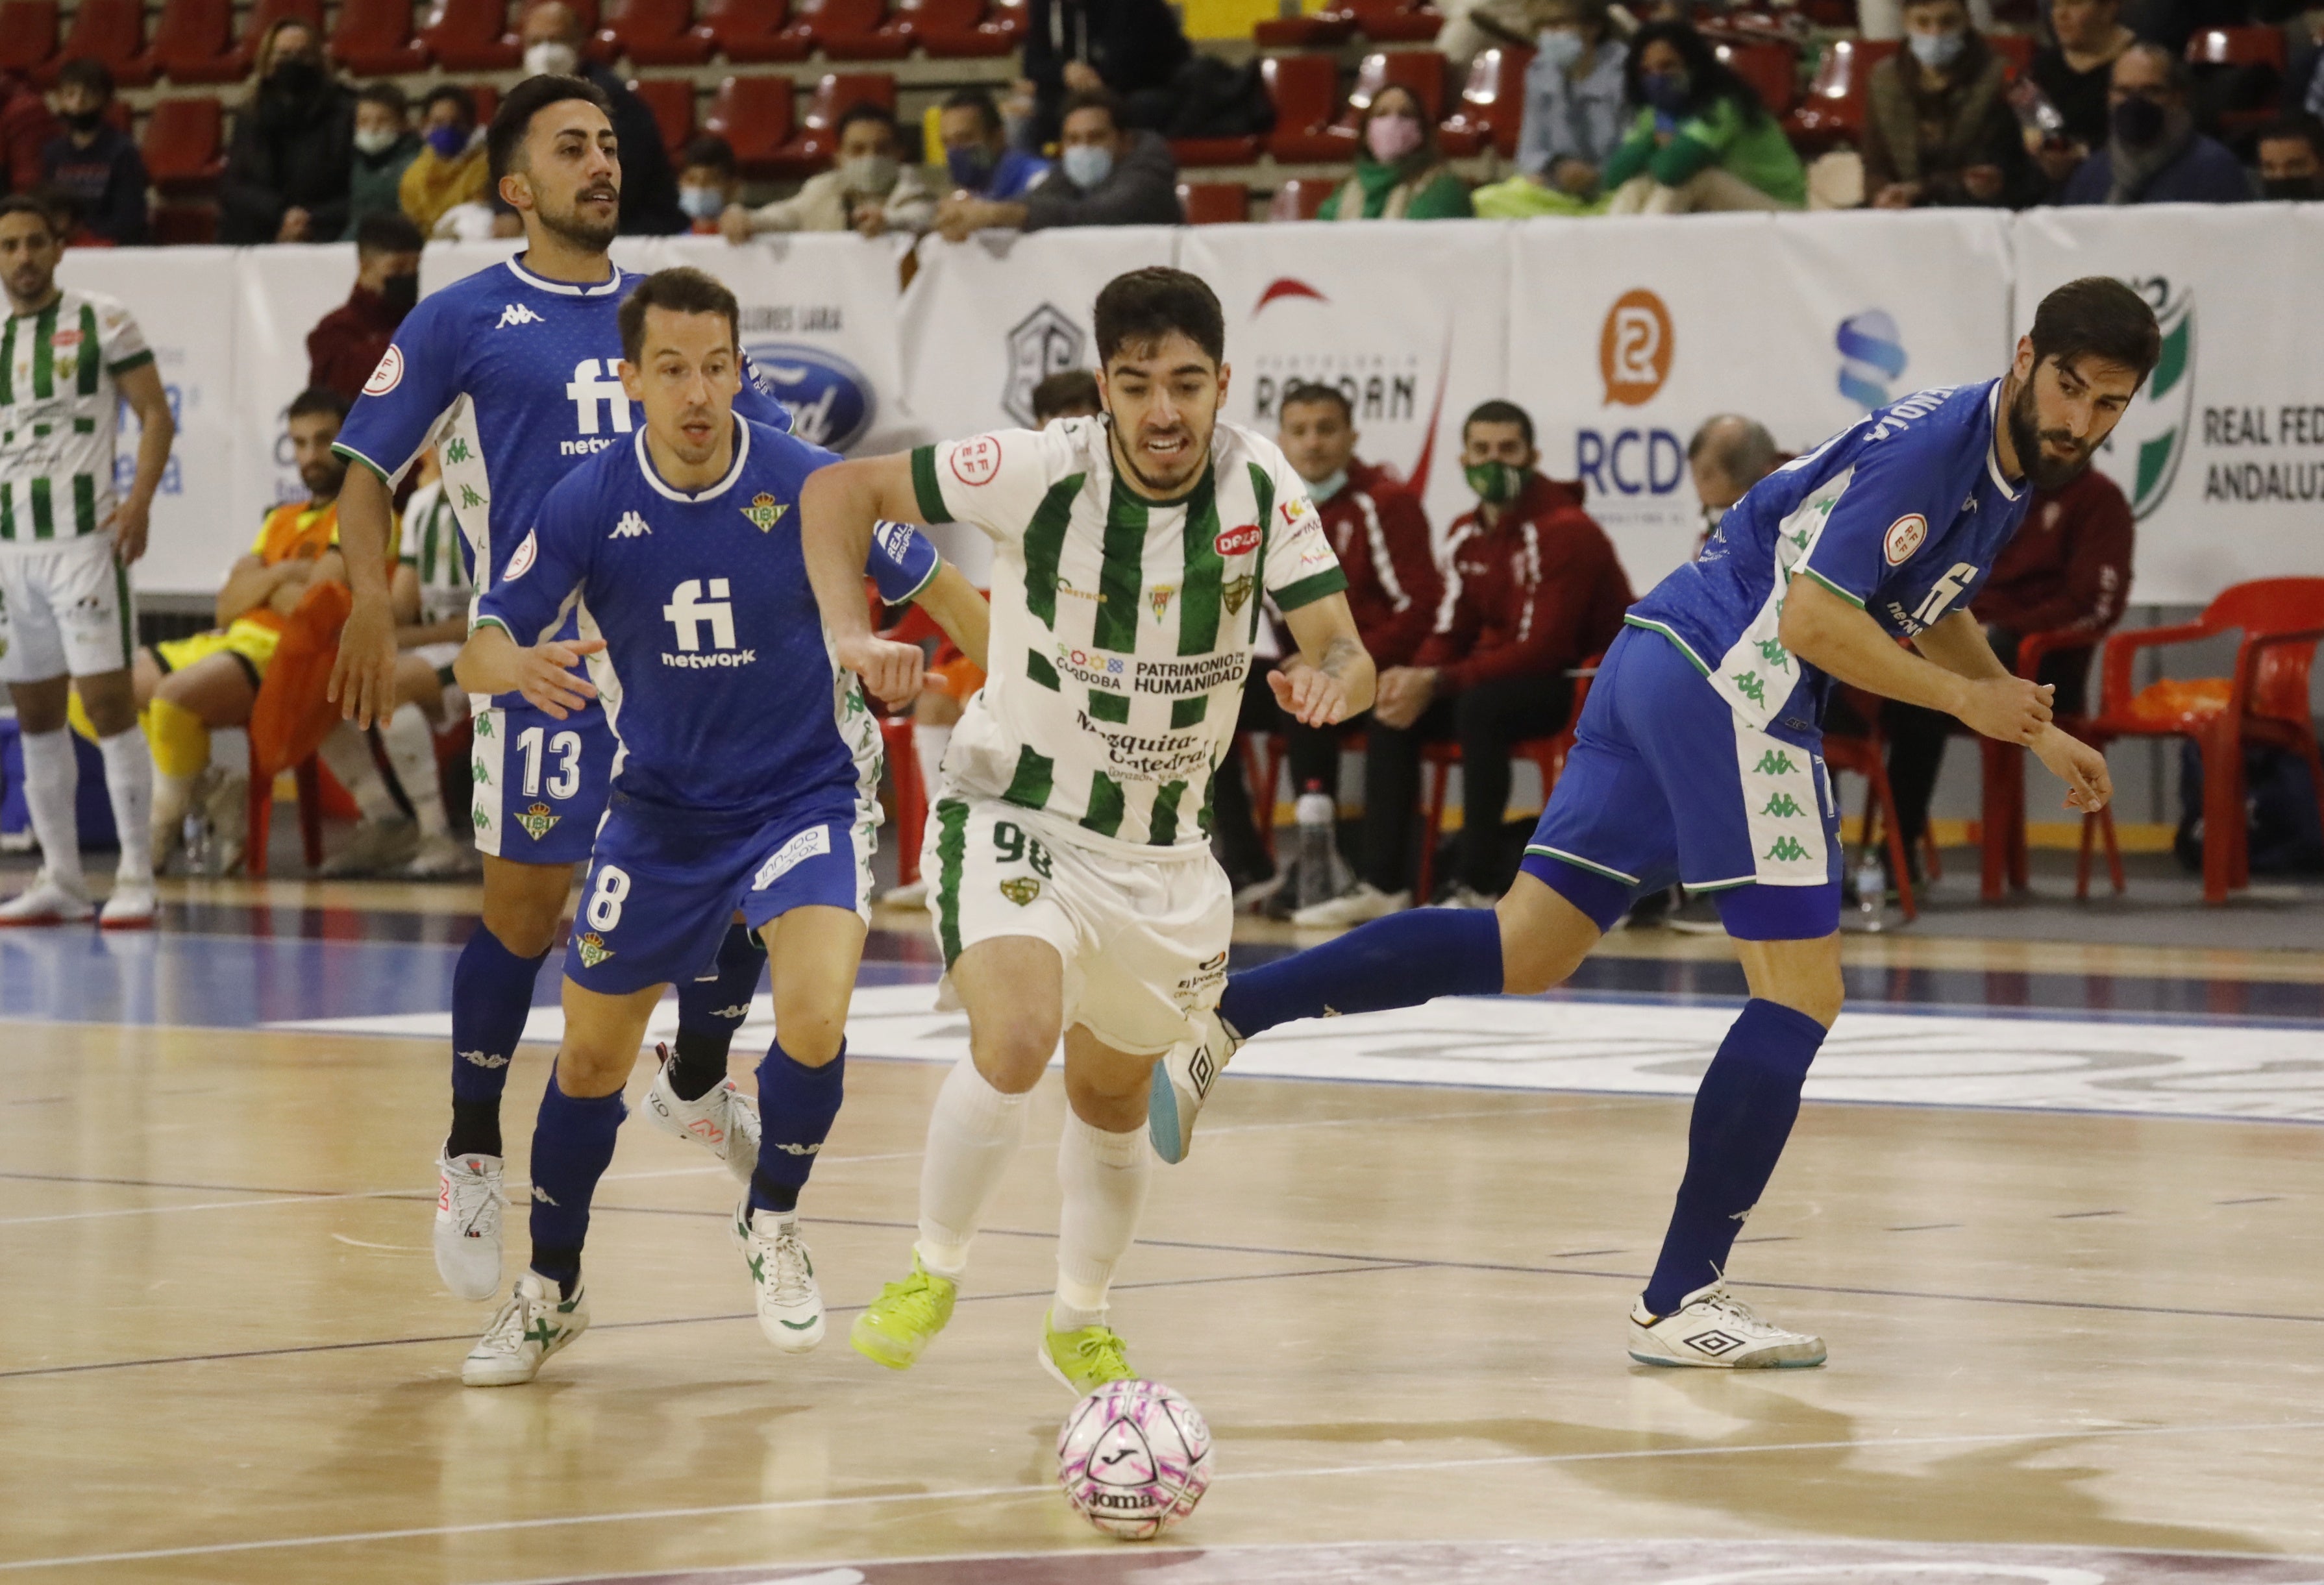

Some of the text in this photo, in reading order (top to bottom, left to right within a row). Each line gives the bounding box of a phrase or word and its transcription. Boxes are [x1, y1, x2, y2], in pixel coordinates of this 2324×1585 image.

[2205, 406, 2269, 445] REAL
[1576, 428, 1683, 497] RCD
[2206, 462, 2324, 502] ANDALU
[663, 578, 736, 651] fi
[661, 649, 756, 669] network
[1136, 654, 1234, 677] PATRIMONIO
[1134, 666, 1244, 694] HUMANIDAD
[517, 726, 582, 800] 13
[587, 865, 631, 932] 8
